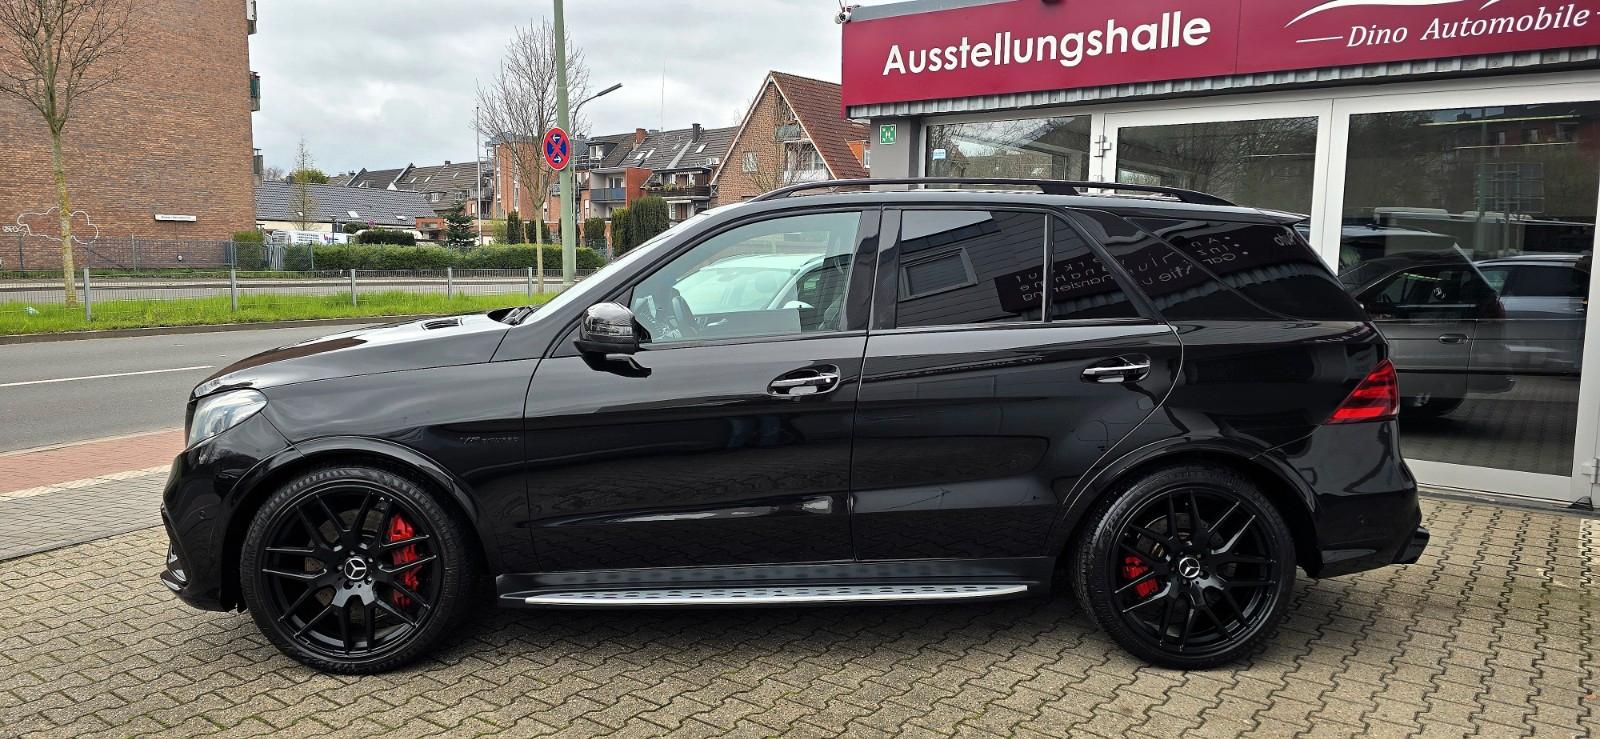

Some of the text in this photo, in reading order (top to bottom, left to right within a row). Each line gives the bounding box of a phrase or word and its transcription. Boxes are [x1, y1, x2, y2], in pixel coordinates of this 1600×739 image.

[882, 11, 1211, 75] Ausstellungshalle
[1347, 4, 1590, 47] Dino Automobile
